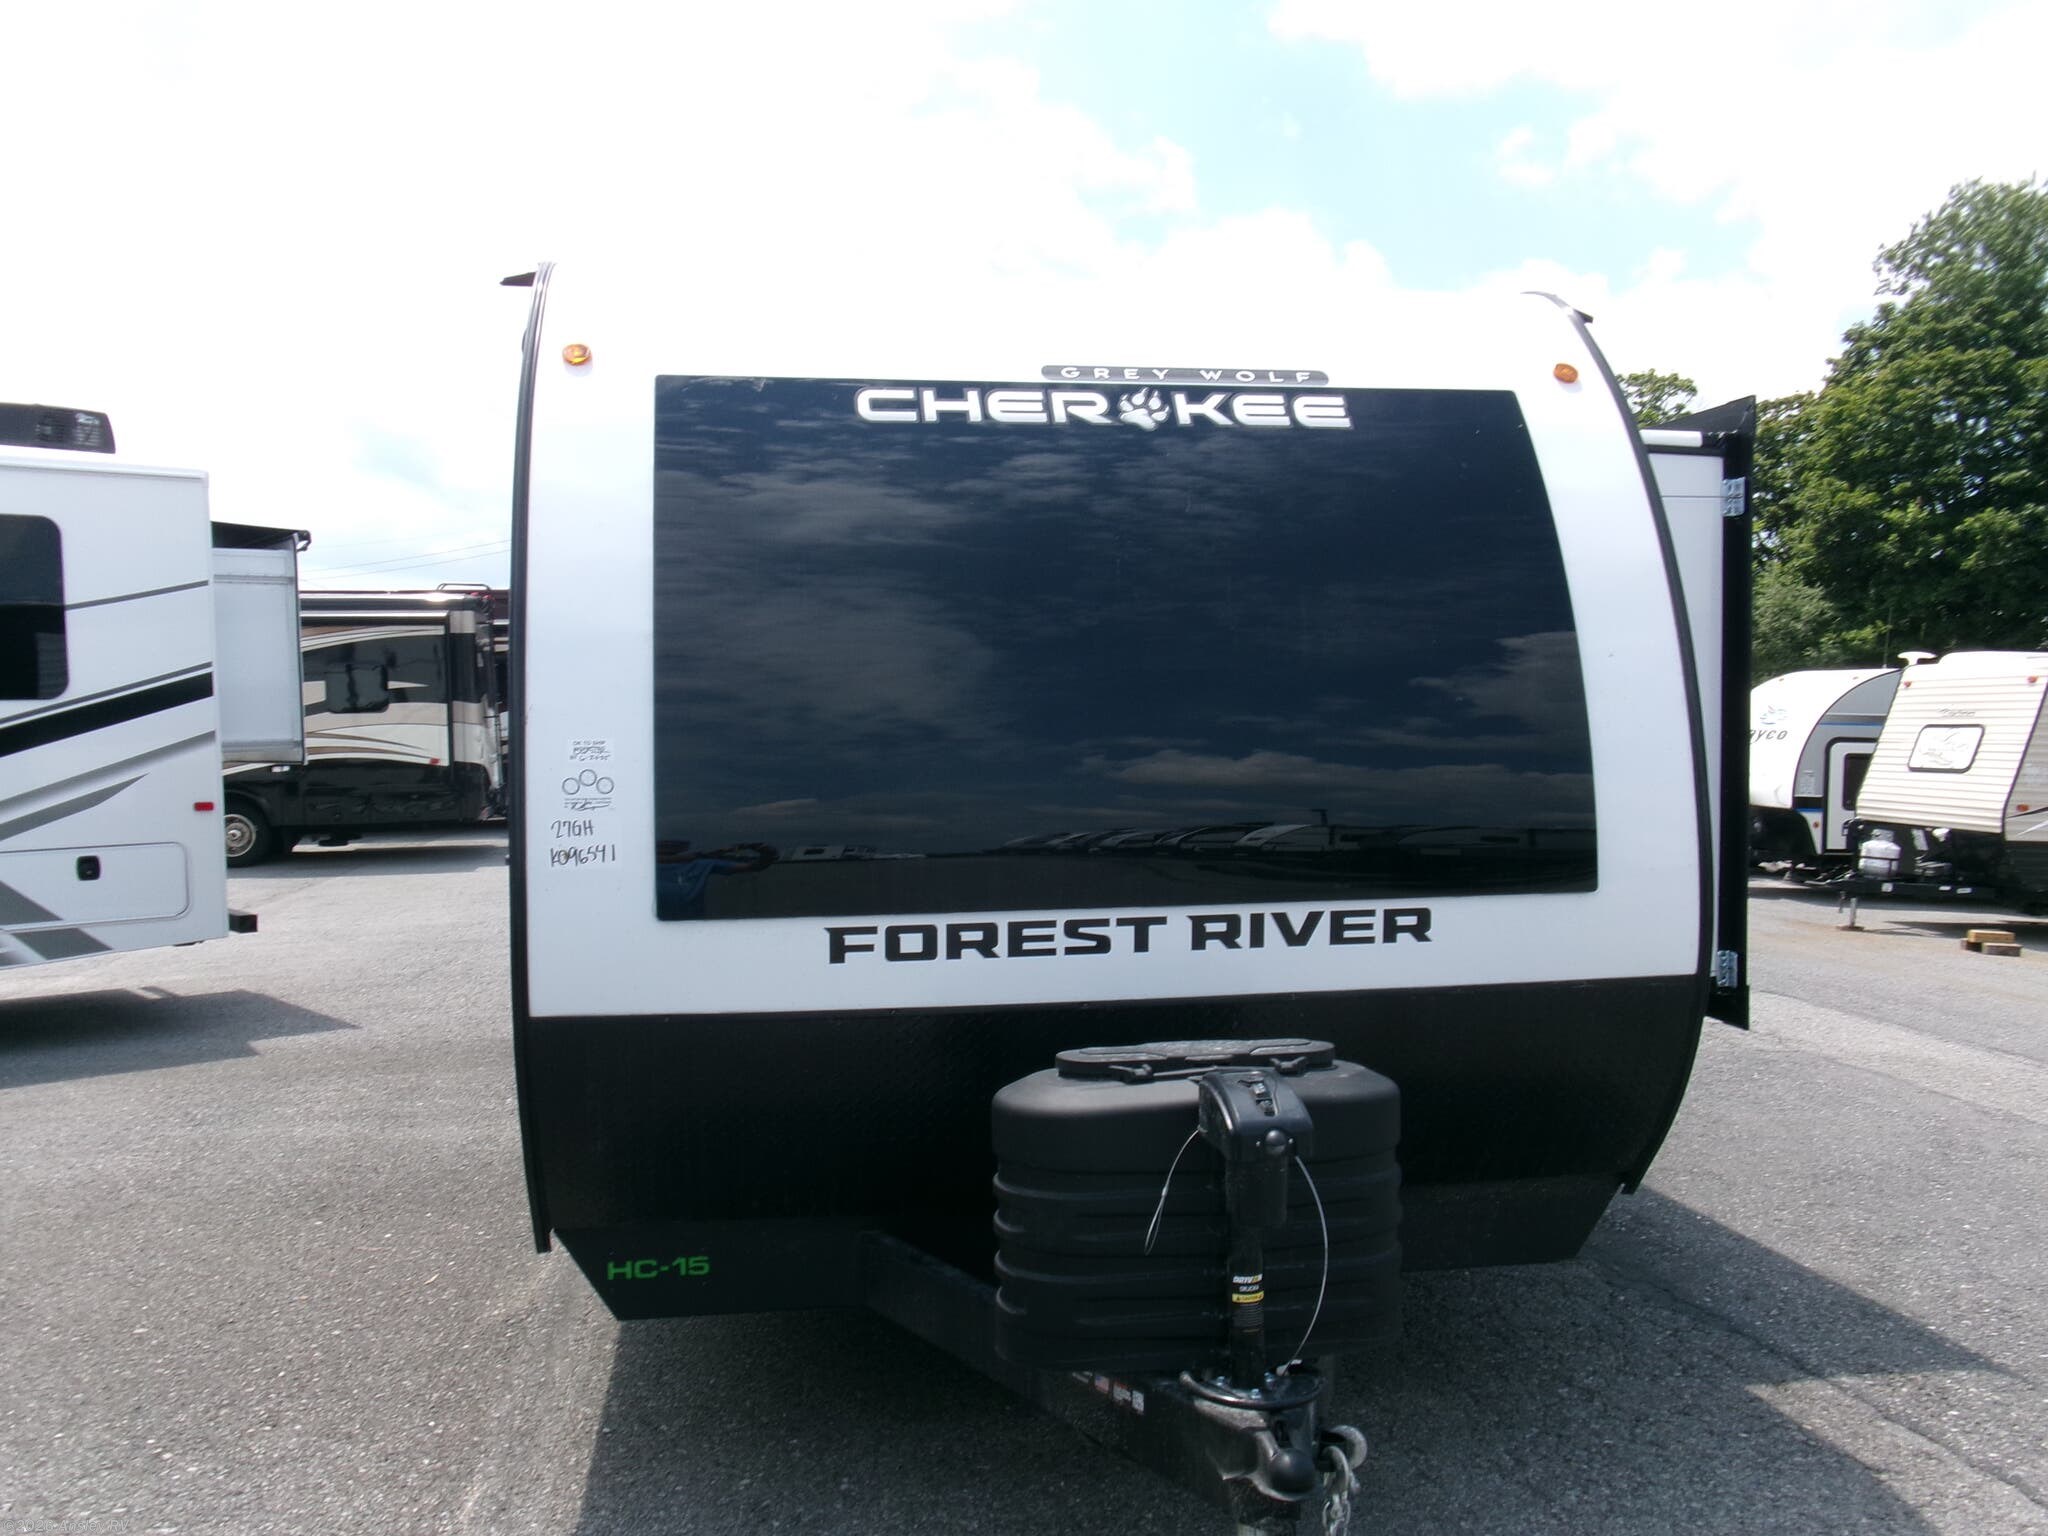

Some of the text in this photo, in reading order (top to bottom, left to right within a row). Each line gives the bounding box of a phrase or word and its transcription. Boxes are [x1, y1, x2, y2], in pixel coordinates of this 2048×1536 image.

[1060, 366, 1312, 383] GREY WOLF
[855, 387, 1355, 431] CHERKEE
[823, 907, 1433, 965] FOREST RIVER
[607, 1255, 710, 1280] HC-15
